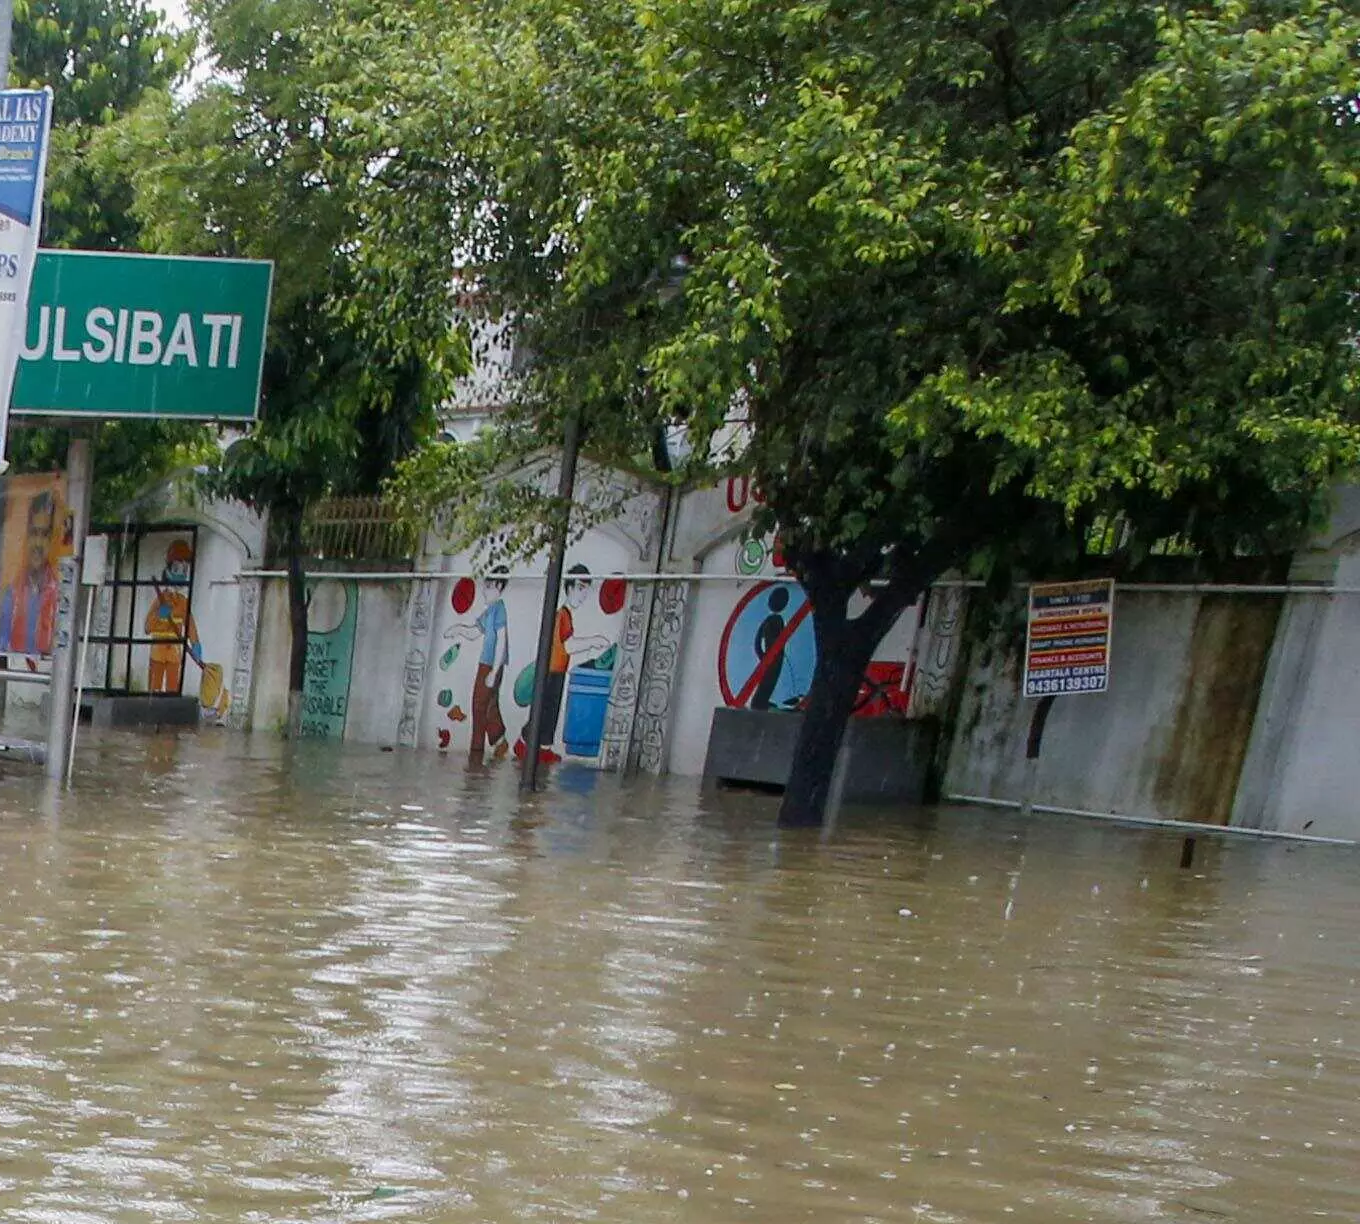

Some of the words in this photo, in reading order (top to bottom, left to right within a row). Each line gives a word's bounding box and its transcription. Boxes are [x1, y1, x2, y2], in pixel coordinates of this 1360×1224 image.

[15, 97, 42, 122] IAS
[1028, 668, 1070, 679] AGARTALA
[1072, 665, 1105, 676] CENTRE
[1027, 675, 1106, 693] 9436139307
